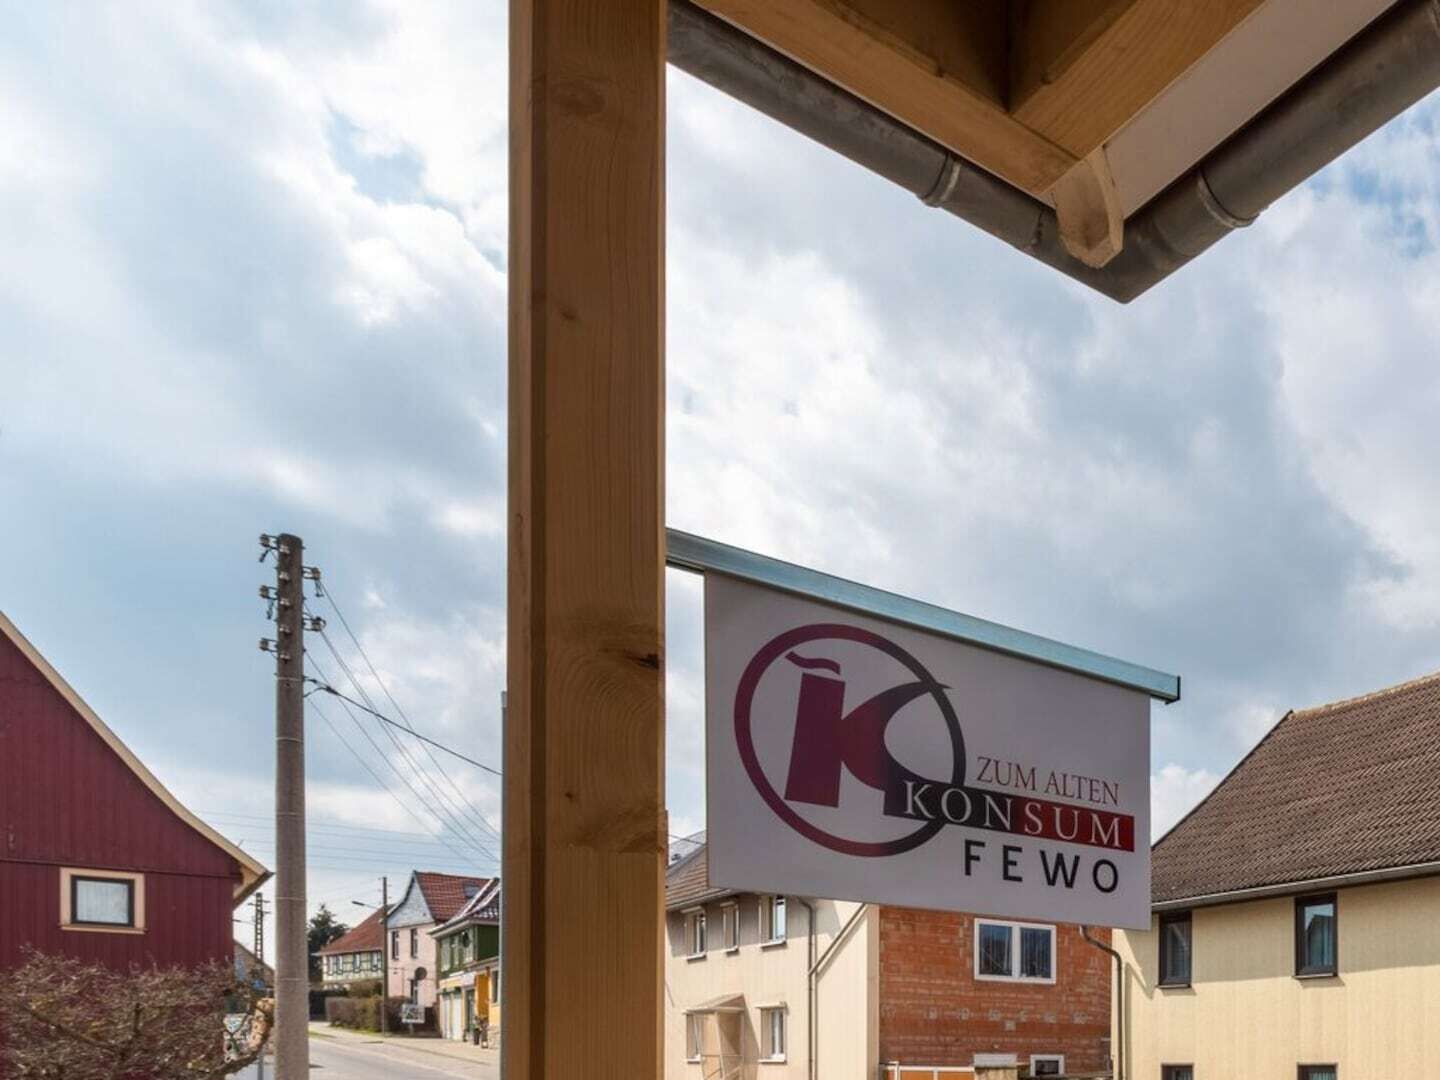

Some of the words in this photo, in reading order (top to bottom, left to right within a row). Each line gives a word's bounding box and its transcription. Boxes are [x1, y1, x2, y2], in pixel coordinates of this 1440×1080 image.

[977, 757, 1037, 791] ZUM
[1044, 771, 1119, 806] ALTEN
[903, 781, 1122, 848] KONSUM
[964, 839, 1119, 893] FEWO
